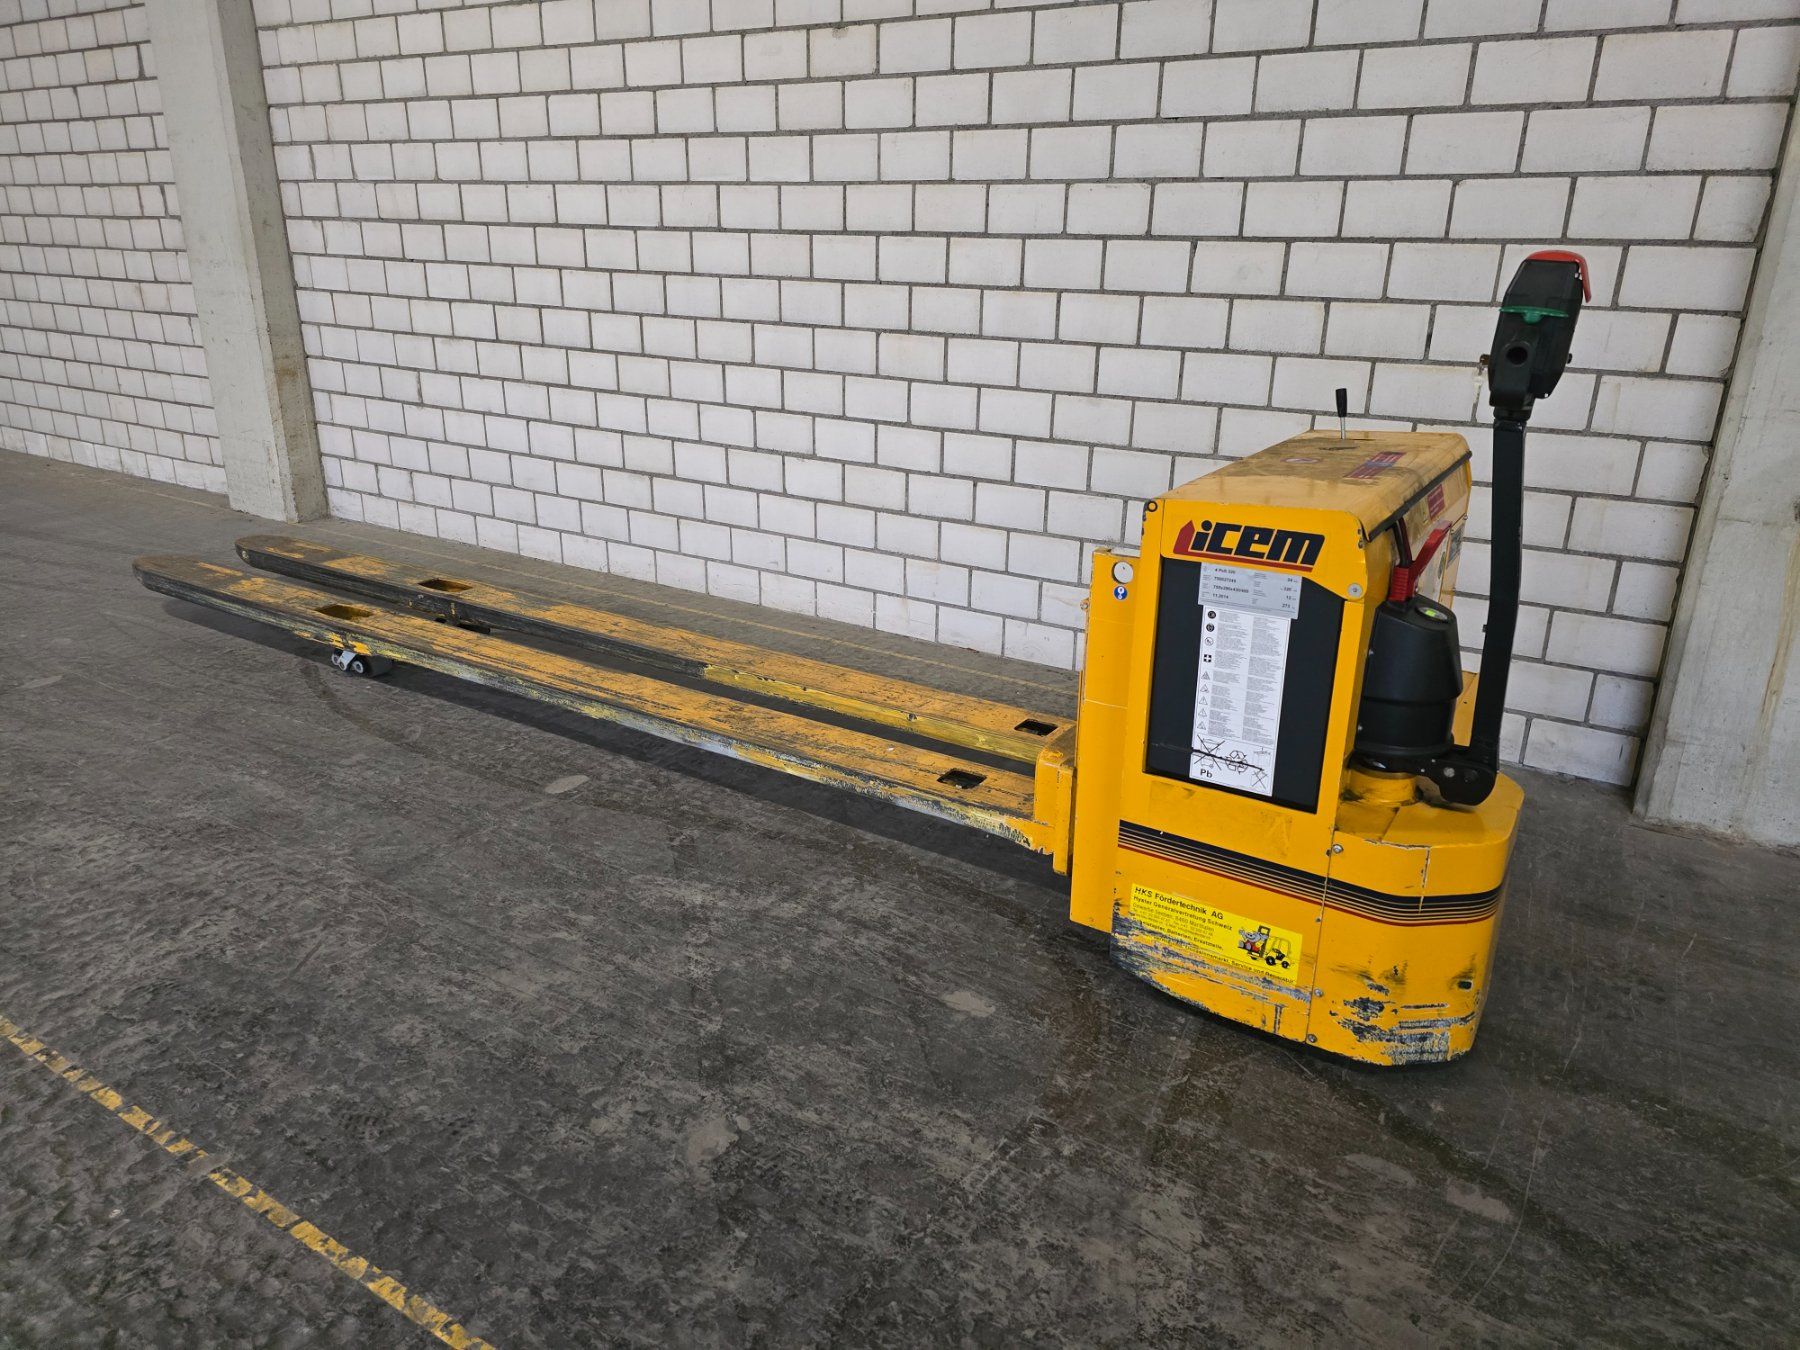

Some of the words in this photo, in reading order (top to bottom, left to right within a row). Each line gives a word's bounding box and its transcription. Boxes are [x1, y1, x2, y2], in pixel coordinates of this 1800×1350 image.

[1191, 520, 1325, 565] icem
[1200, 768, 1213, 778] Pb
[1135, 886, 1153, 898] HKS
[1154, 893, 1208, 915] Fördertechnik
[1211, 910, 1224, 920] AG
[1207, 918, 1232, 931] Schweiz
